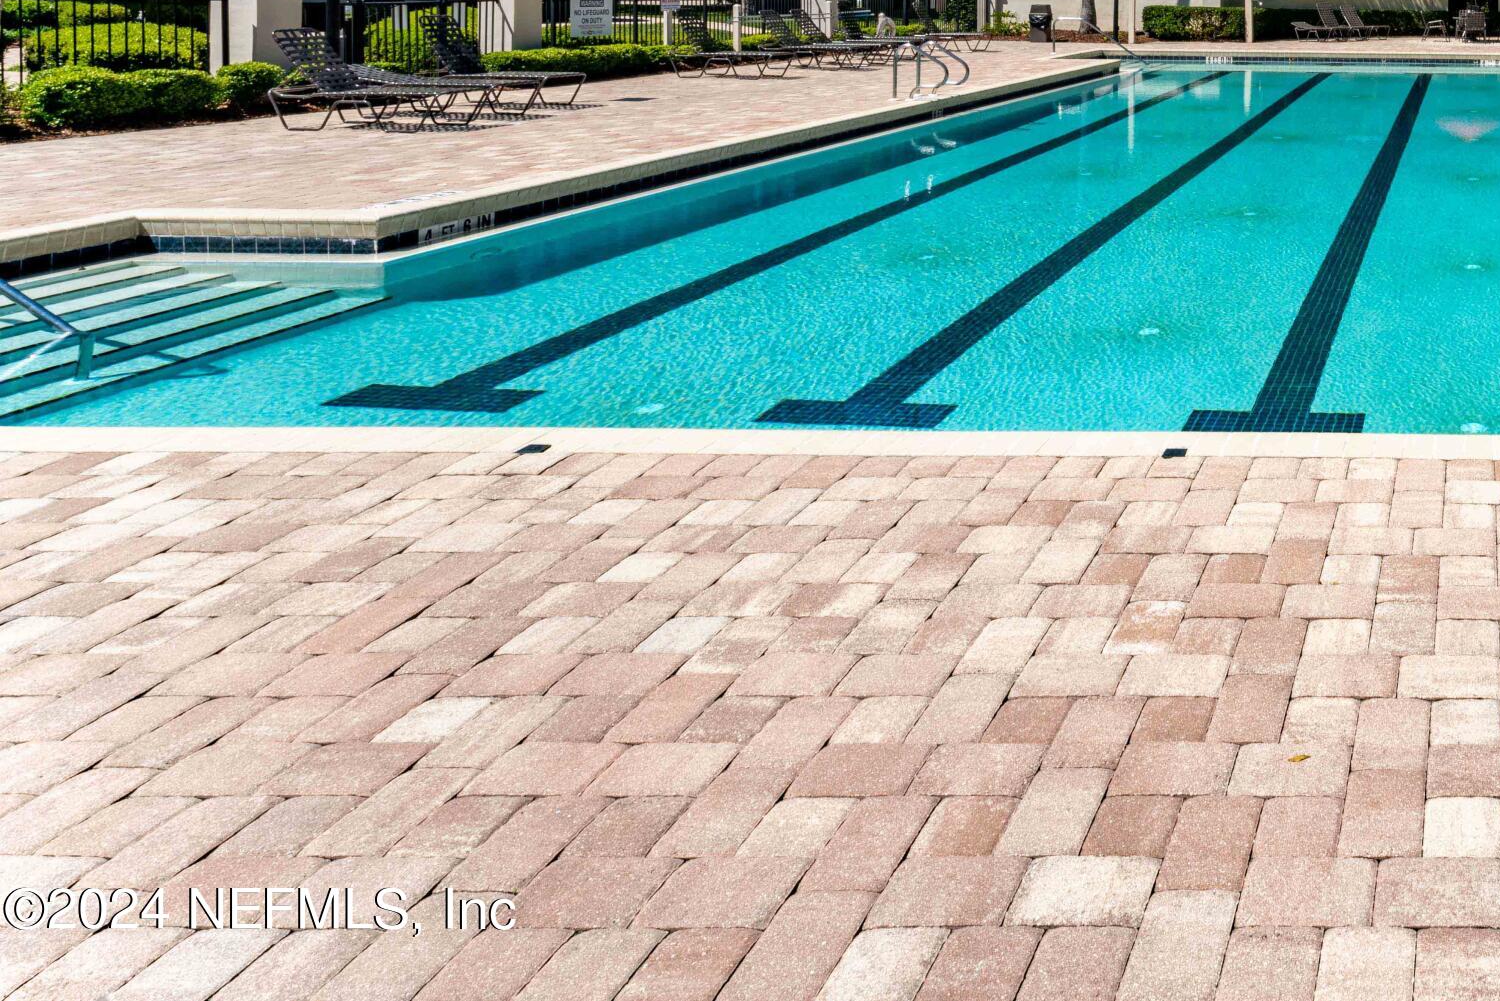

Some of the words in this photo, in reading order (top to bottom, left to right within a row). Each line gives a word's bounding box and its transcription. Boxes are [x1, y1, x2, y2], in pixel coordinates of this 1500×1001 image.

[424, 229, 433, 241] 4
[463, 219, 472, 232] 6
[477, 214, 491, 228] IN
